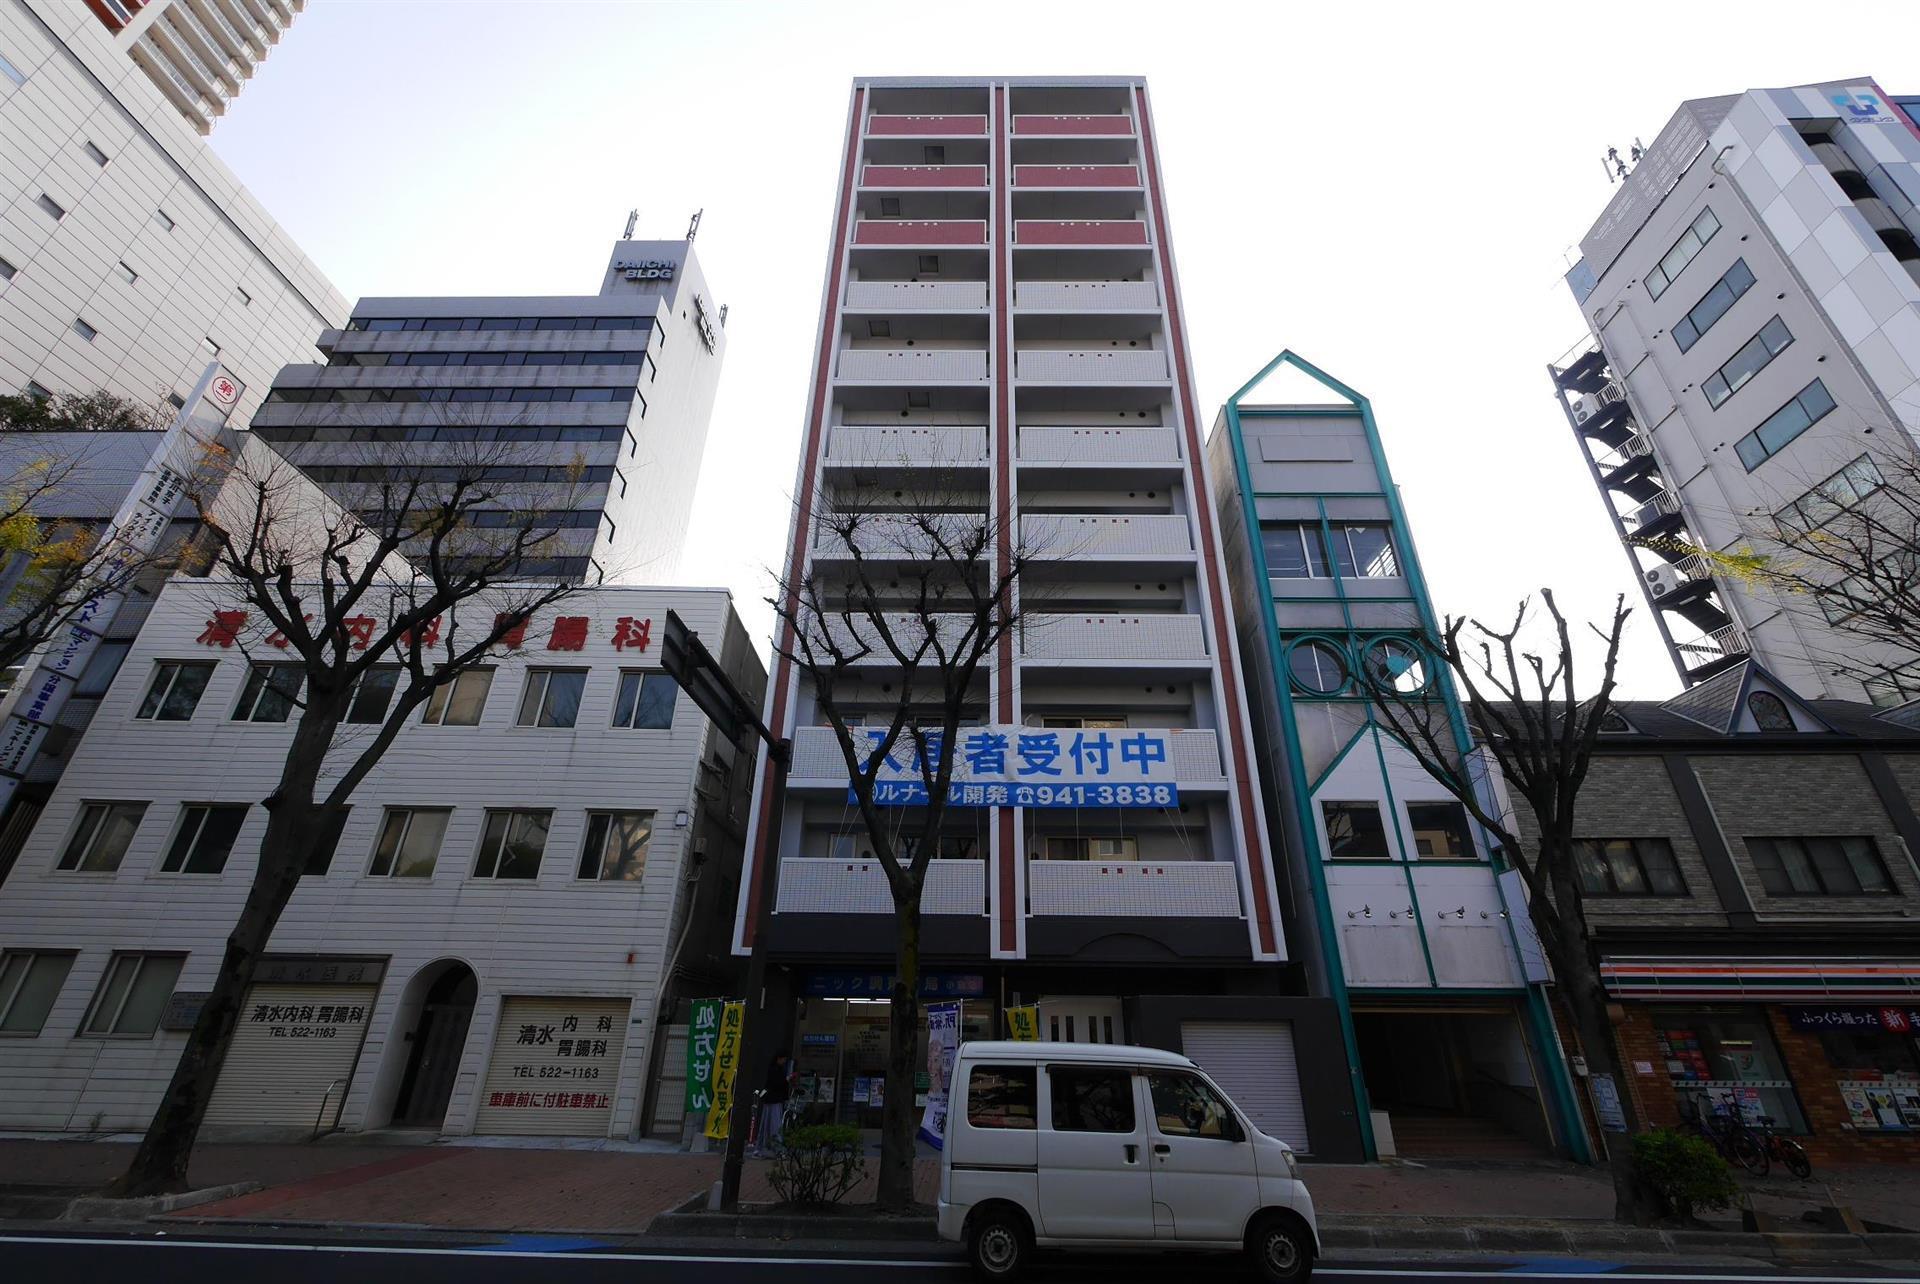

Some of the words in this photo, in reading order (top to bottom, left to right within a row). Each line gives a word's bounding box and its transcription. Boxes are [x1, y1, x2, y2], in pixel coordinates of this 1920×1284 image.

[625, 269, 672, 279] BLDG
[1036, 785, 1171, 806] 941-3838
[250, 1004, 315, 1023] 清水内科
[317, 1005, 364, 1024] 胃腸科
[269, 1026, 289, 1037] TEL
[290, 1026, 337, 1038] 522-1163
[516, 1024, 556, 1045] 清水
[557, 1039, 608, 1057] 胃腸科
[513, 1066, 535, 1078] TEL
[539, 1066, 600, 1079] 522-1163
[488, 1092, 609, 1109] 車庫前に付駐車禁止
